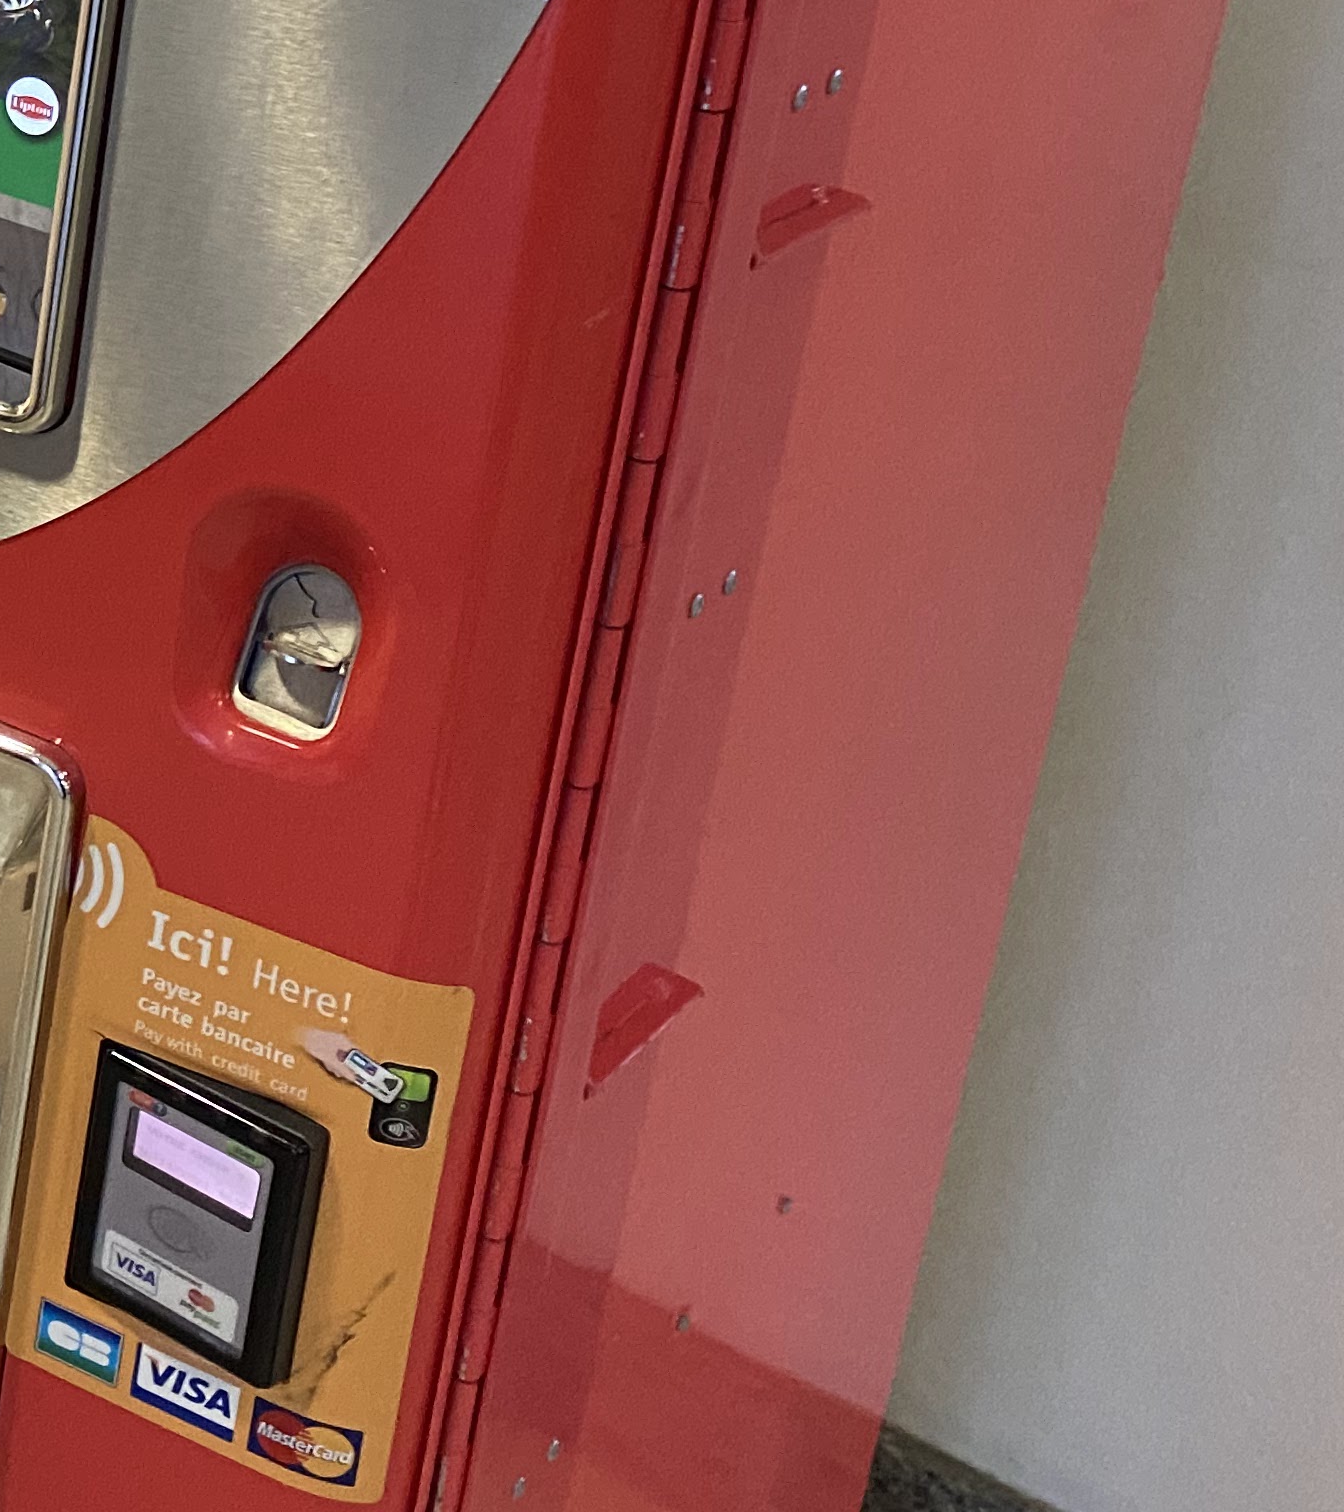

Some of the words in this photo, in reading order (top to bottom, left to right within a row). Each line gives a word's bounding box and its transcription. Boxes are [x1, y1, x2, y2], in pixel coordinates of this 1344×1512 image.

[12, 96, 53, 118] Lipton
[147, 909, 235, 976] Ici!
[252, 957, 354, 1025] Here!
[141, 968, 202, 1009] Payez
[214, 997, 251, 1026] par
[133, 1019, 163, 1046] Pay
[165, 1030, 203, 1059] with
[211, 1051, 260, 1085] credit
[270, 1072, 309, 1103] card
[137, 995, 193, 1029] carte
[201, 1012, 296, 1070] bancaire
[116, 1252, 156, 1287] VISA
[147, 1358, 233, 1419] VISA
[257, 1418, 353, 1467] MasterCard
